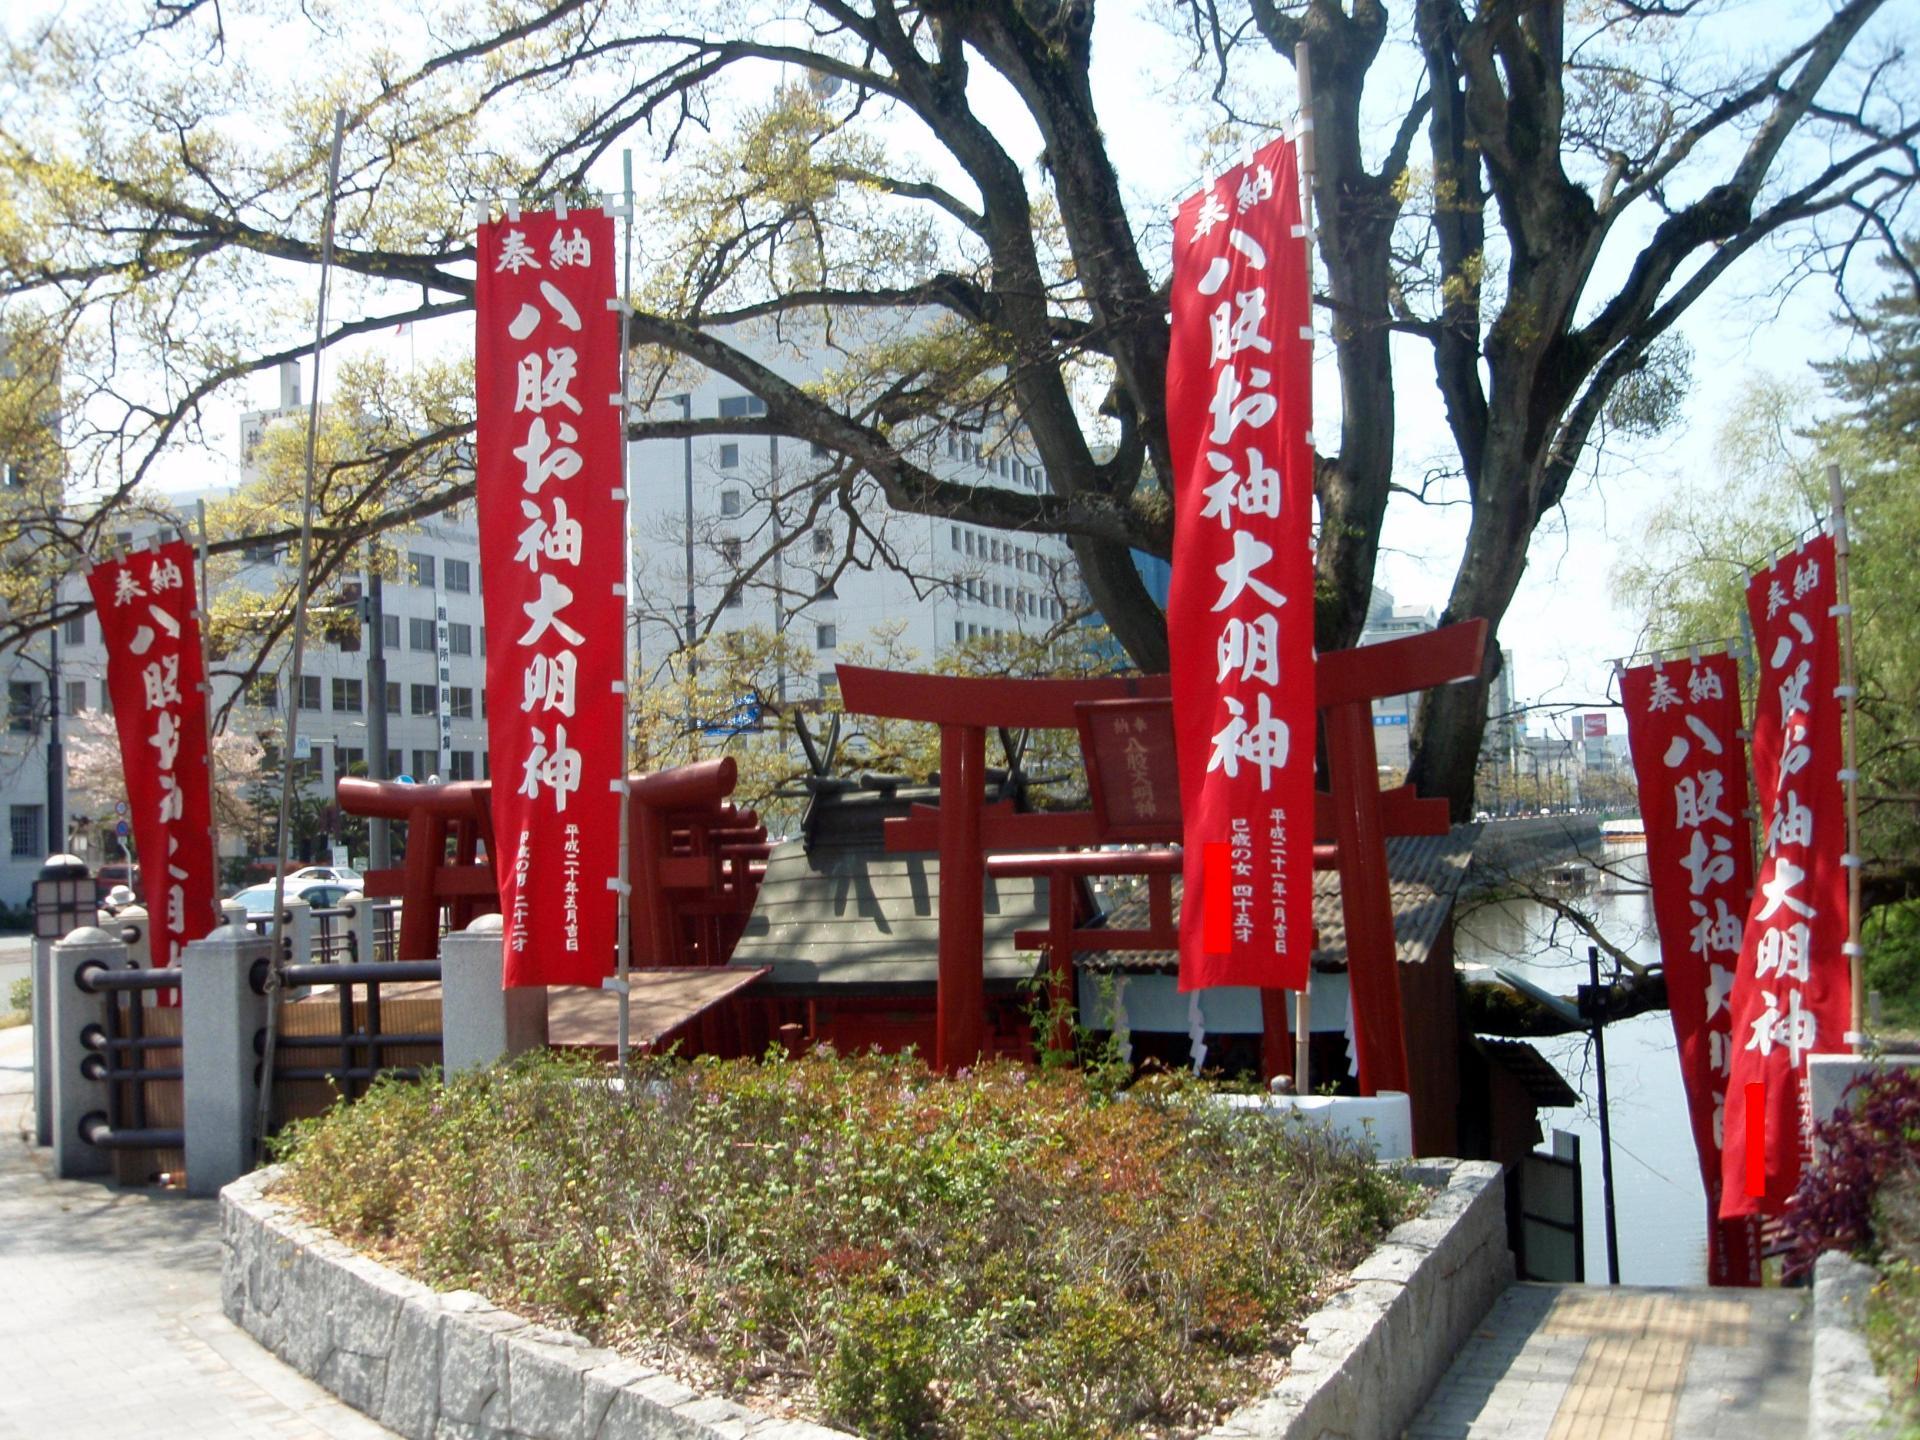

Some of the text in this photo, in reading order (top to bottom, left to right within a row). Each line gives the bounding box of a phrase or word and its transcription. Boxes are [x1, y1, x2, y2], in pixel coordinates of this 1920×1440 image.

[1190, 164, 1274, 244] 奉納
[495, 227, 591, 275] 奉納
[508, 280, 587, 813] 八股お袖大明神
[1198, 228, 1288, 792] 八股お袖大明神
[114, 558, 184, 607] 奉納
[1766, 559, 1819, 621] 奉納
[1648, 667, 1723, 712] 奉納
[564, 823, 580, 952] 平成二十年五月吉日
[1269, 808, 1287, 955] 平成二十一年一月吉日
